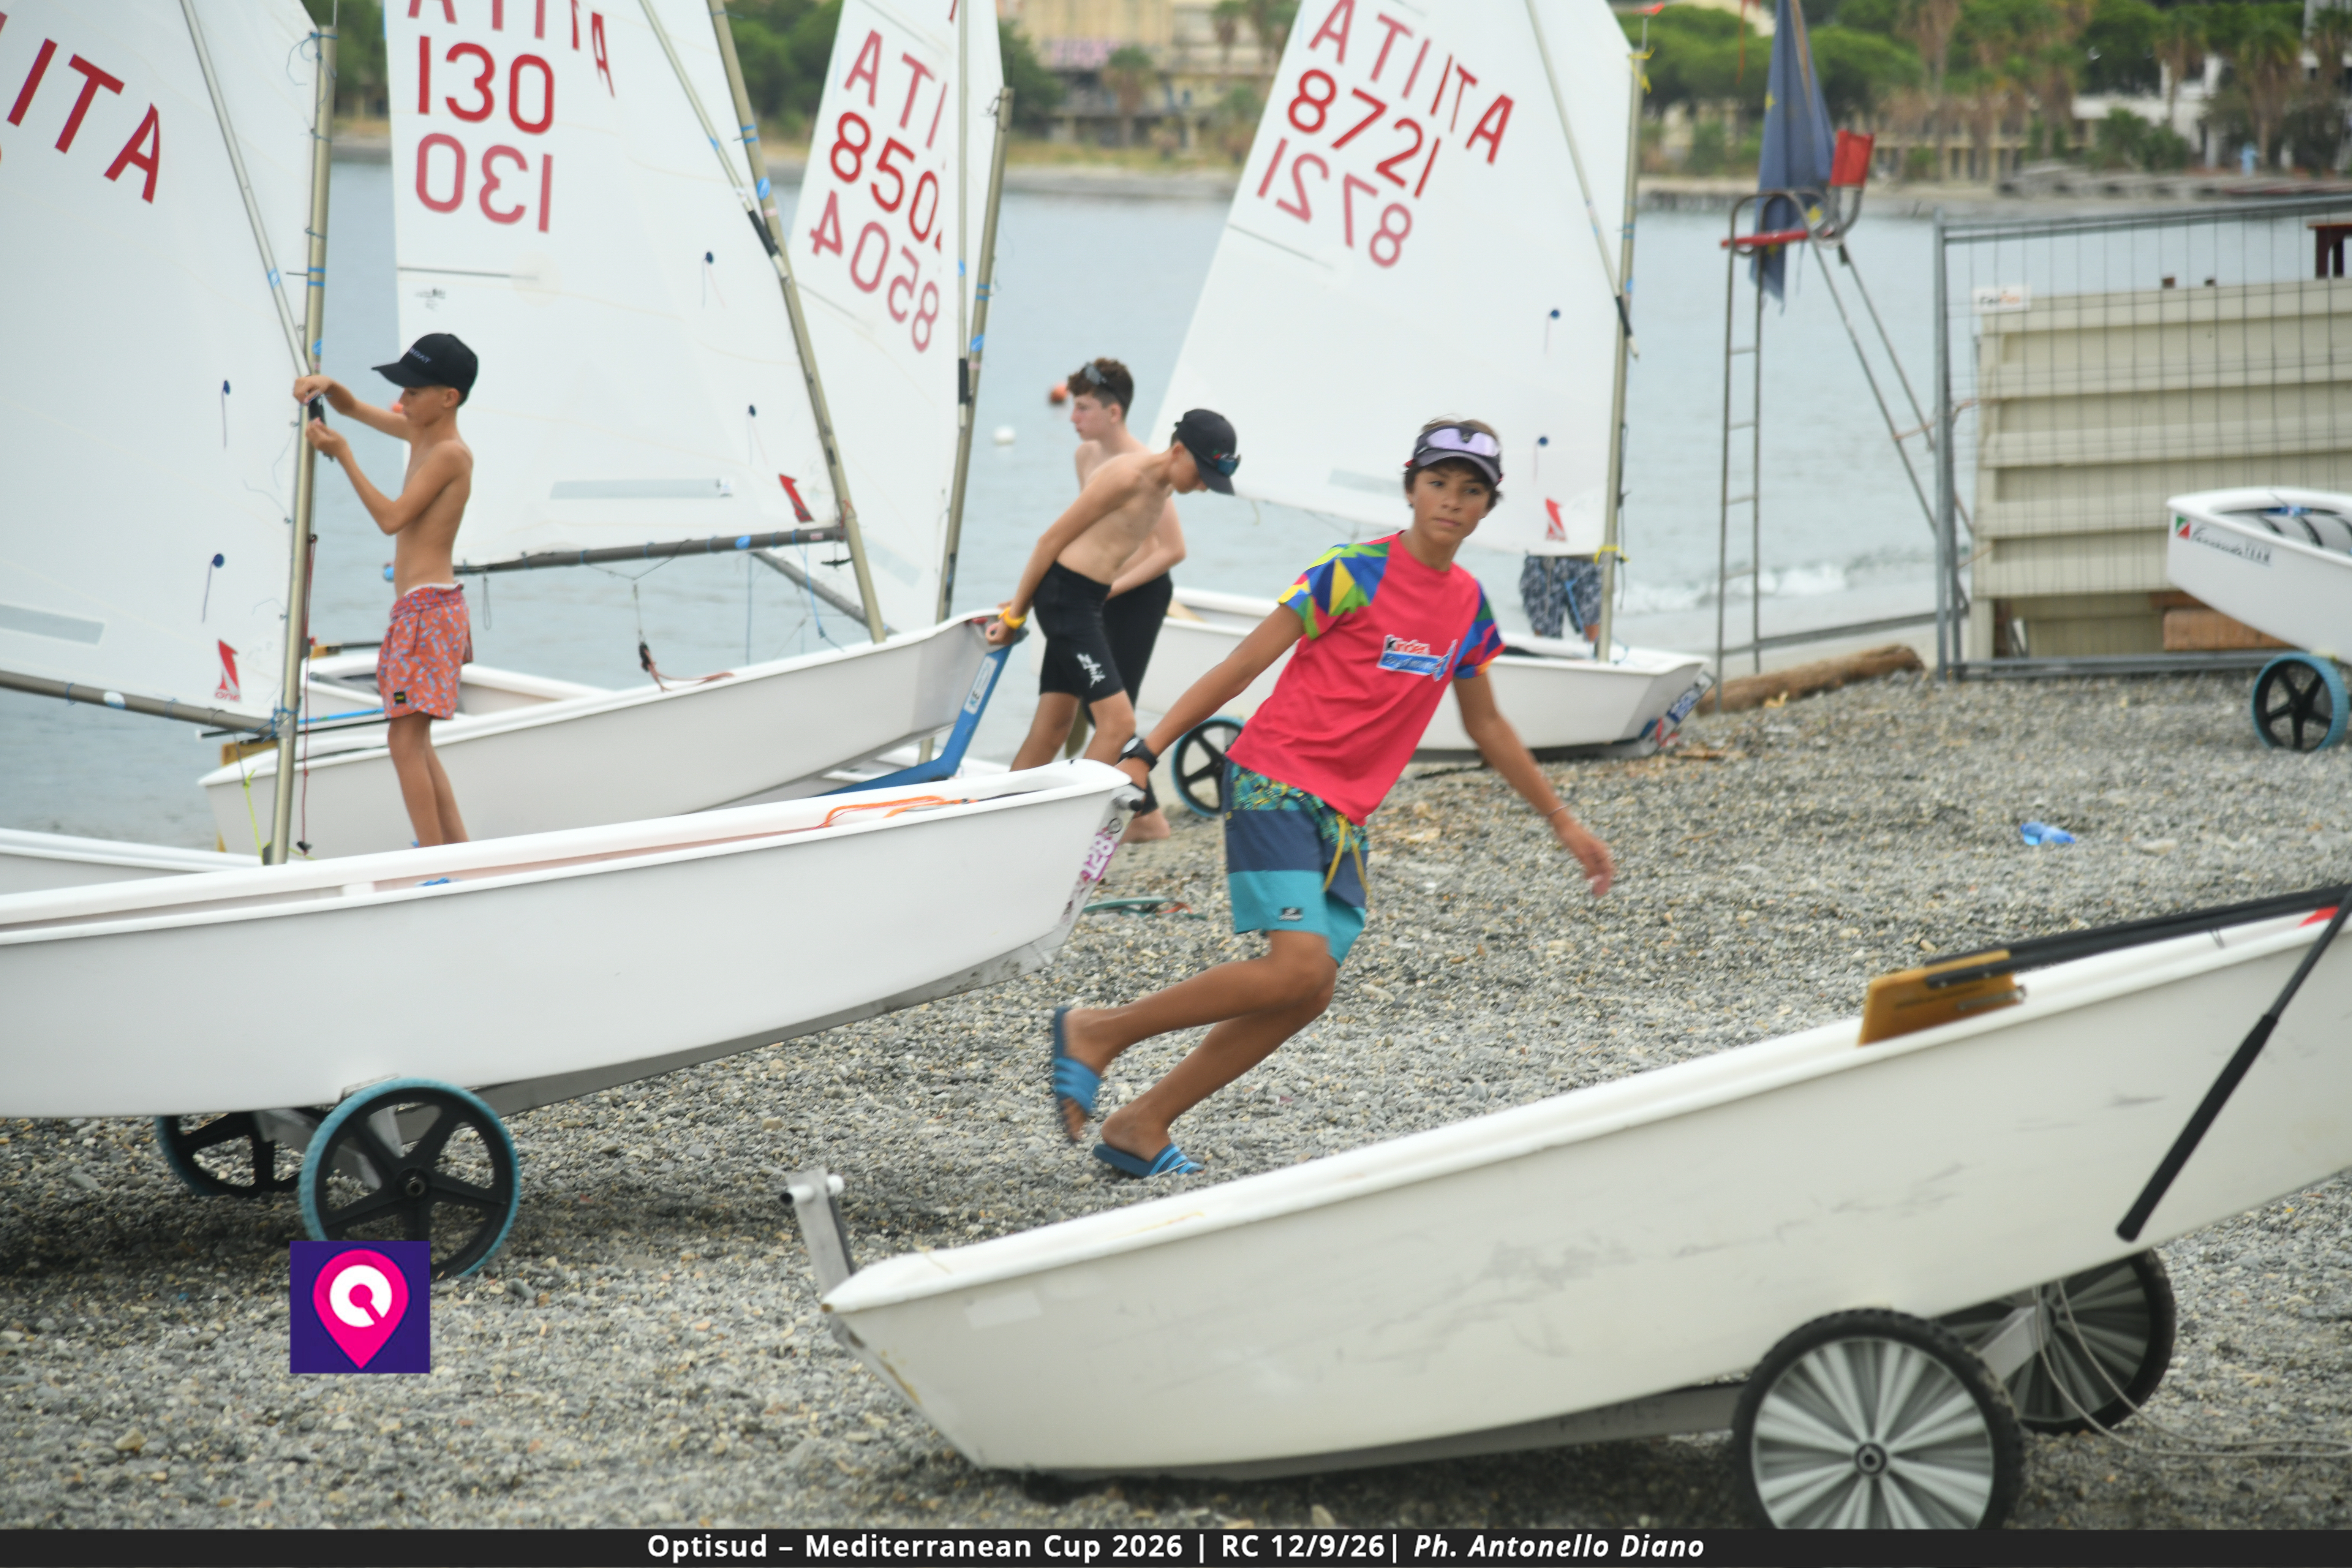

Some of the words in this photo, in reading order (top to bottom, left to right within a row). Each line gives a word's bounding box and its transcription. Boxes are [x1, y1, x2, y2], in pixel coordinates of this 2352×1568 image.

[7, 38, 160, 204] ITA
[418, 35, 554, 135] 130
[1288, 68, 1441, 198] 8721
[1430, 55, 1514, 165] ITA
[830, 111, 942, 254] 850
